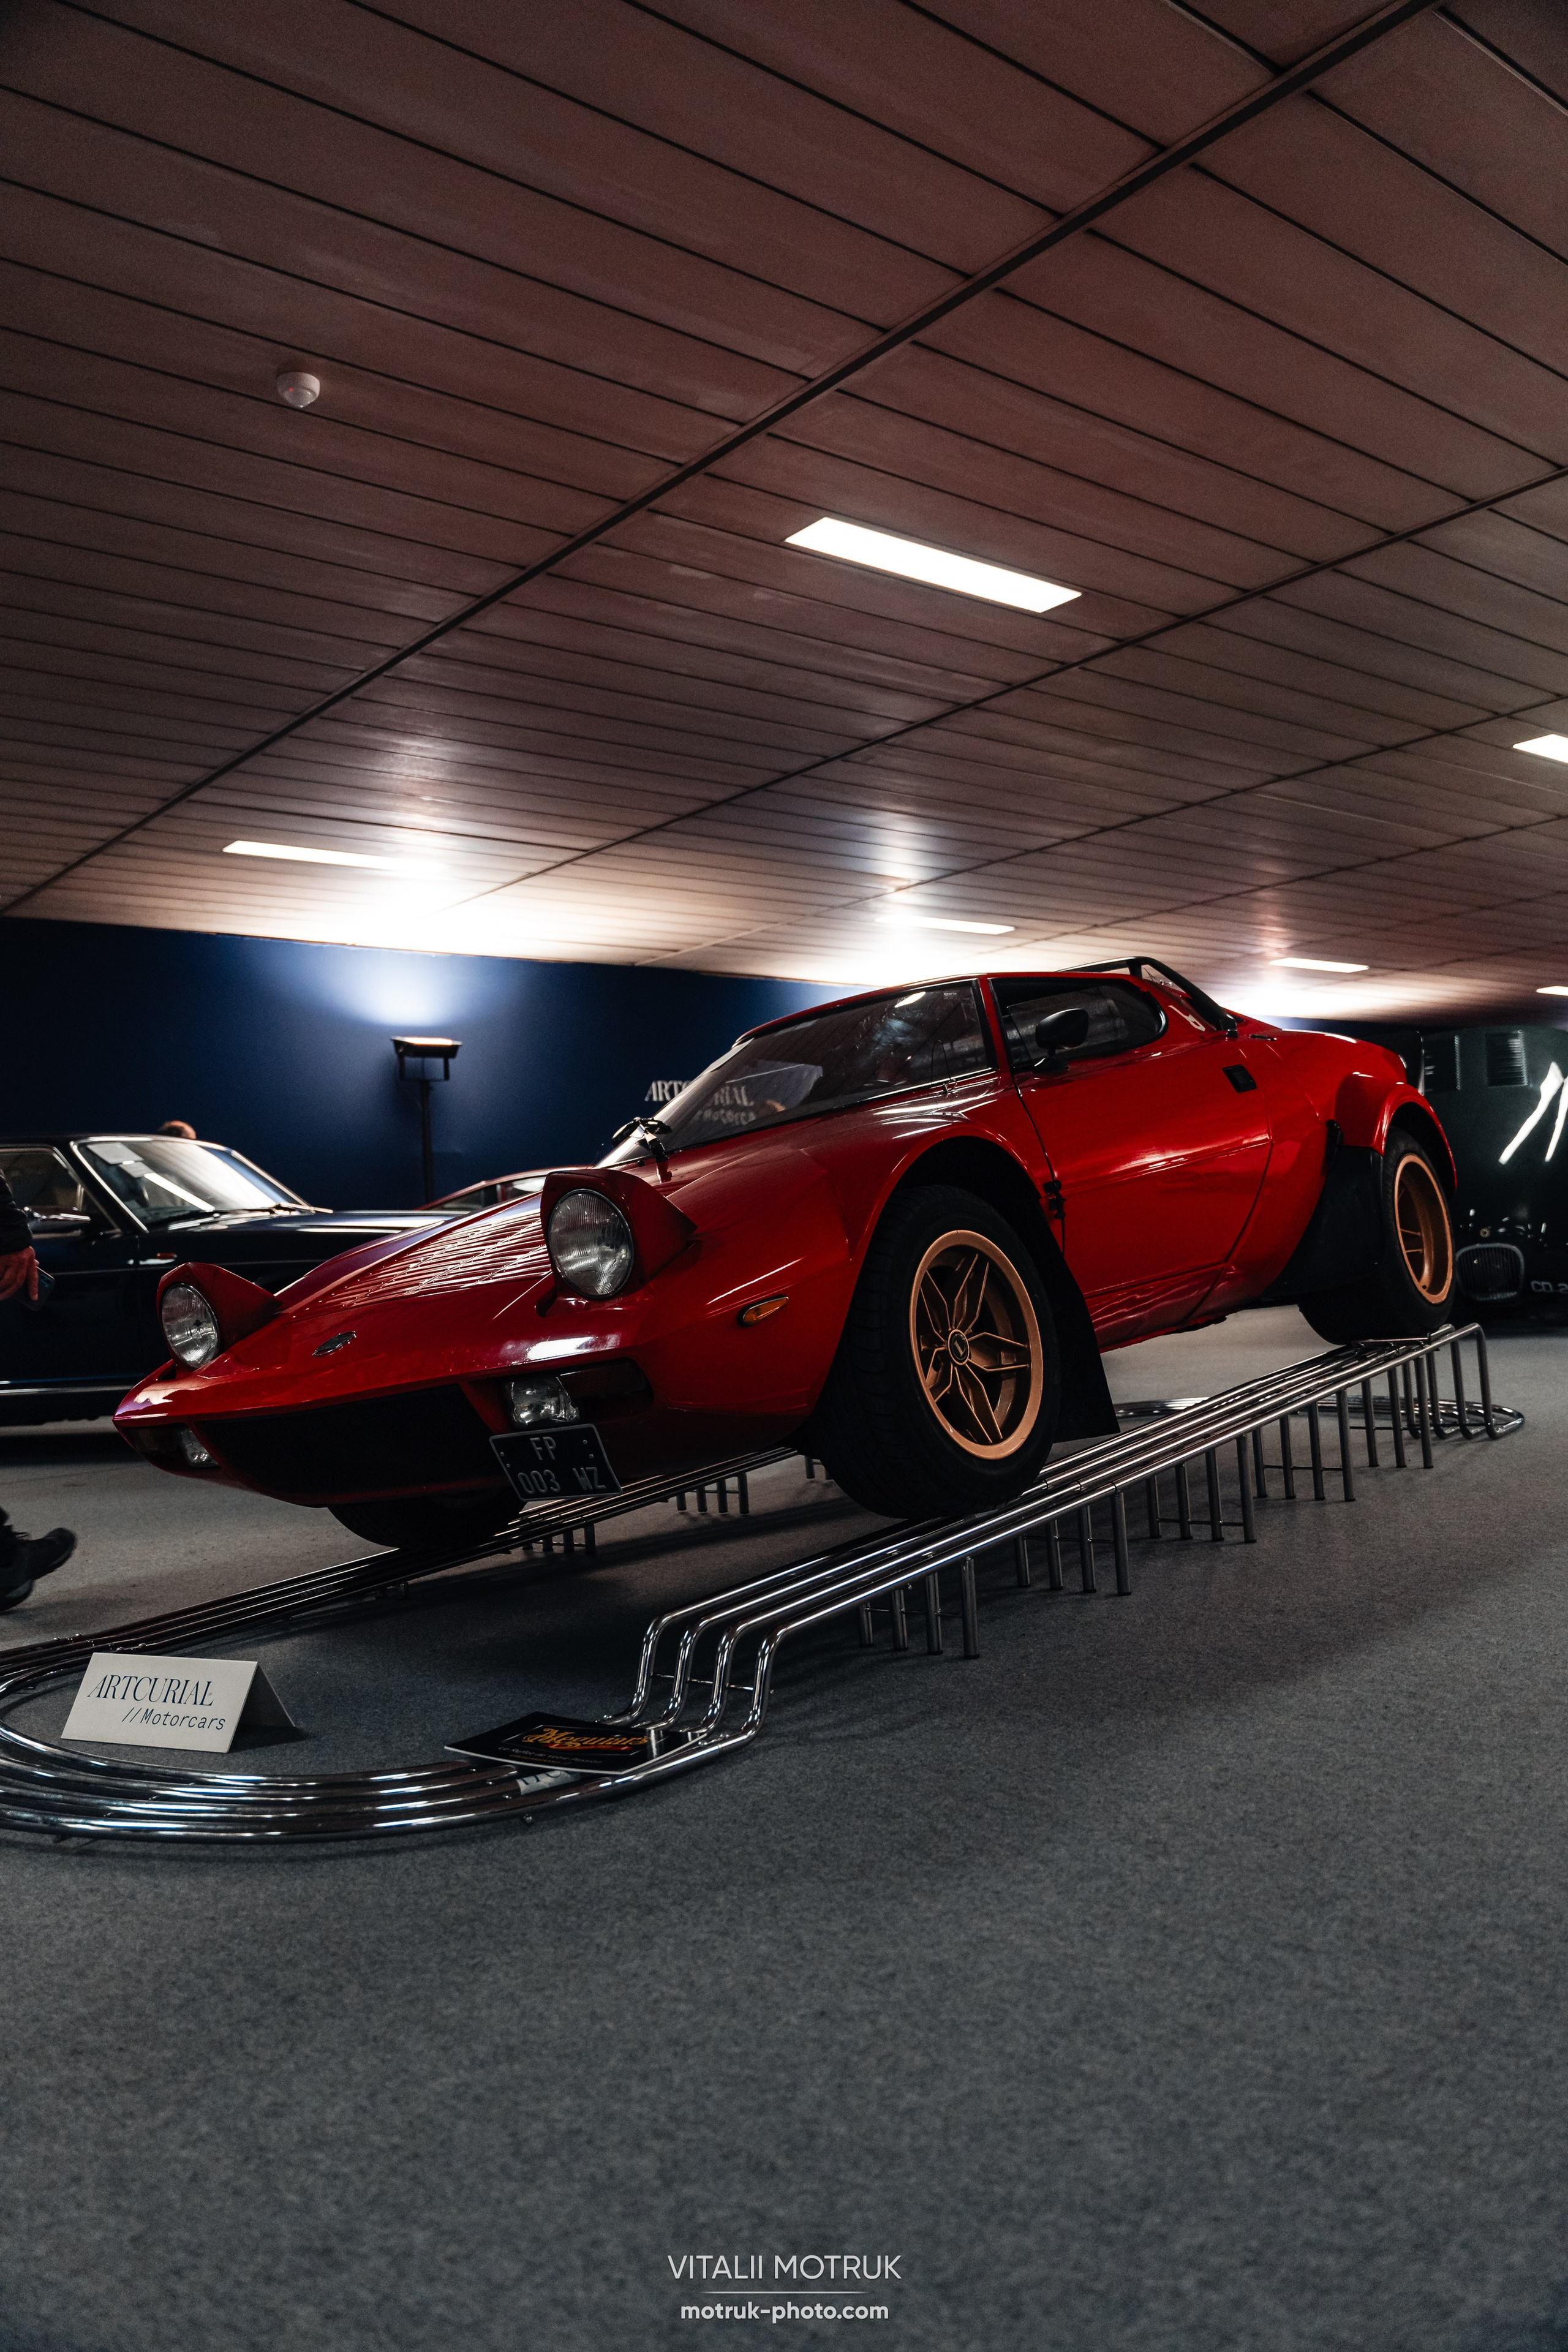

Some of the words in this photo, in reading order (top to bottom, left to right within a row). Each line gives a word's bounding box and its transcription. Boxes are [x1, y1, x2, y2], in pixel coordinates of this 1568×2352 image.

[529, 1436, 557, 1461] FP
[518, 1469, 561, 1494] 003
[572, 1466, 607, 1490] WZ
[87, 1674, 215, 1706] ARTCURIAL
